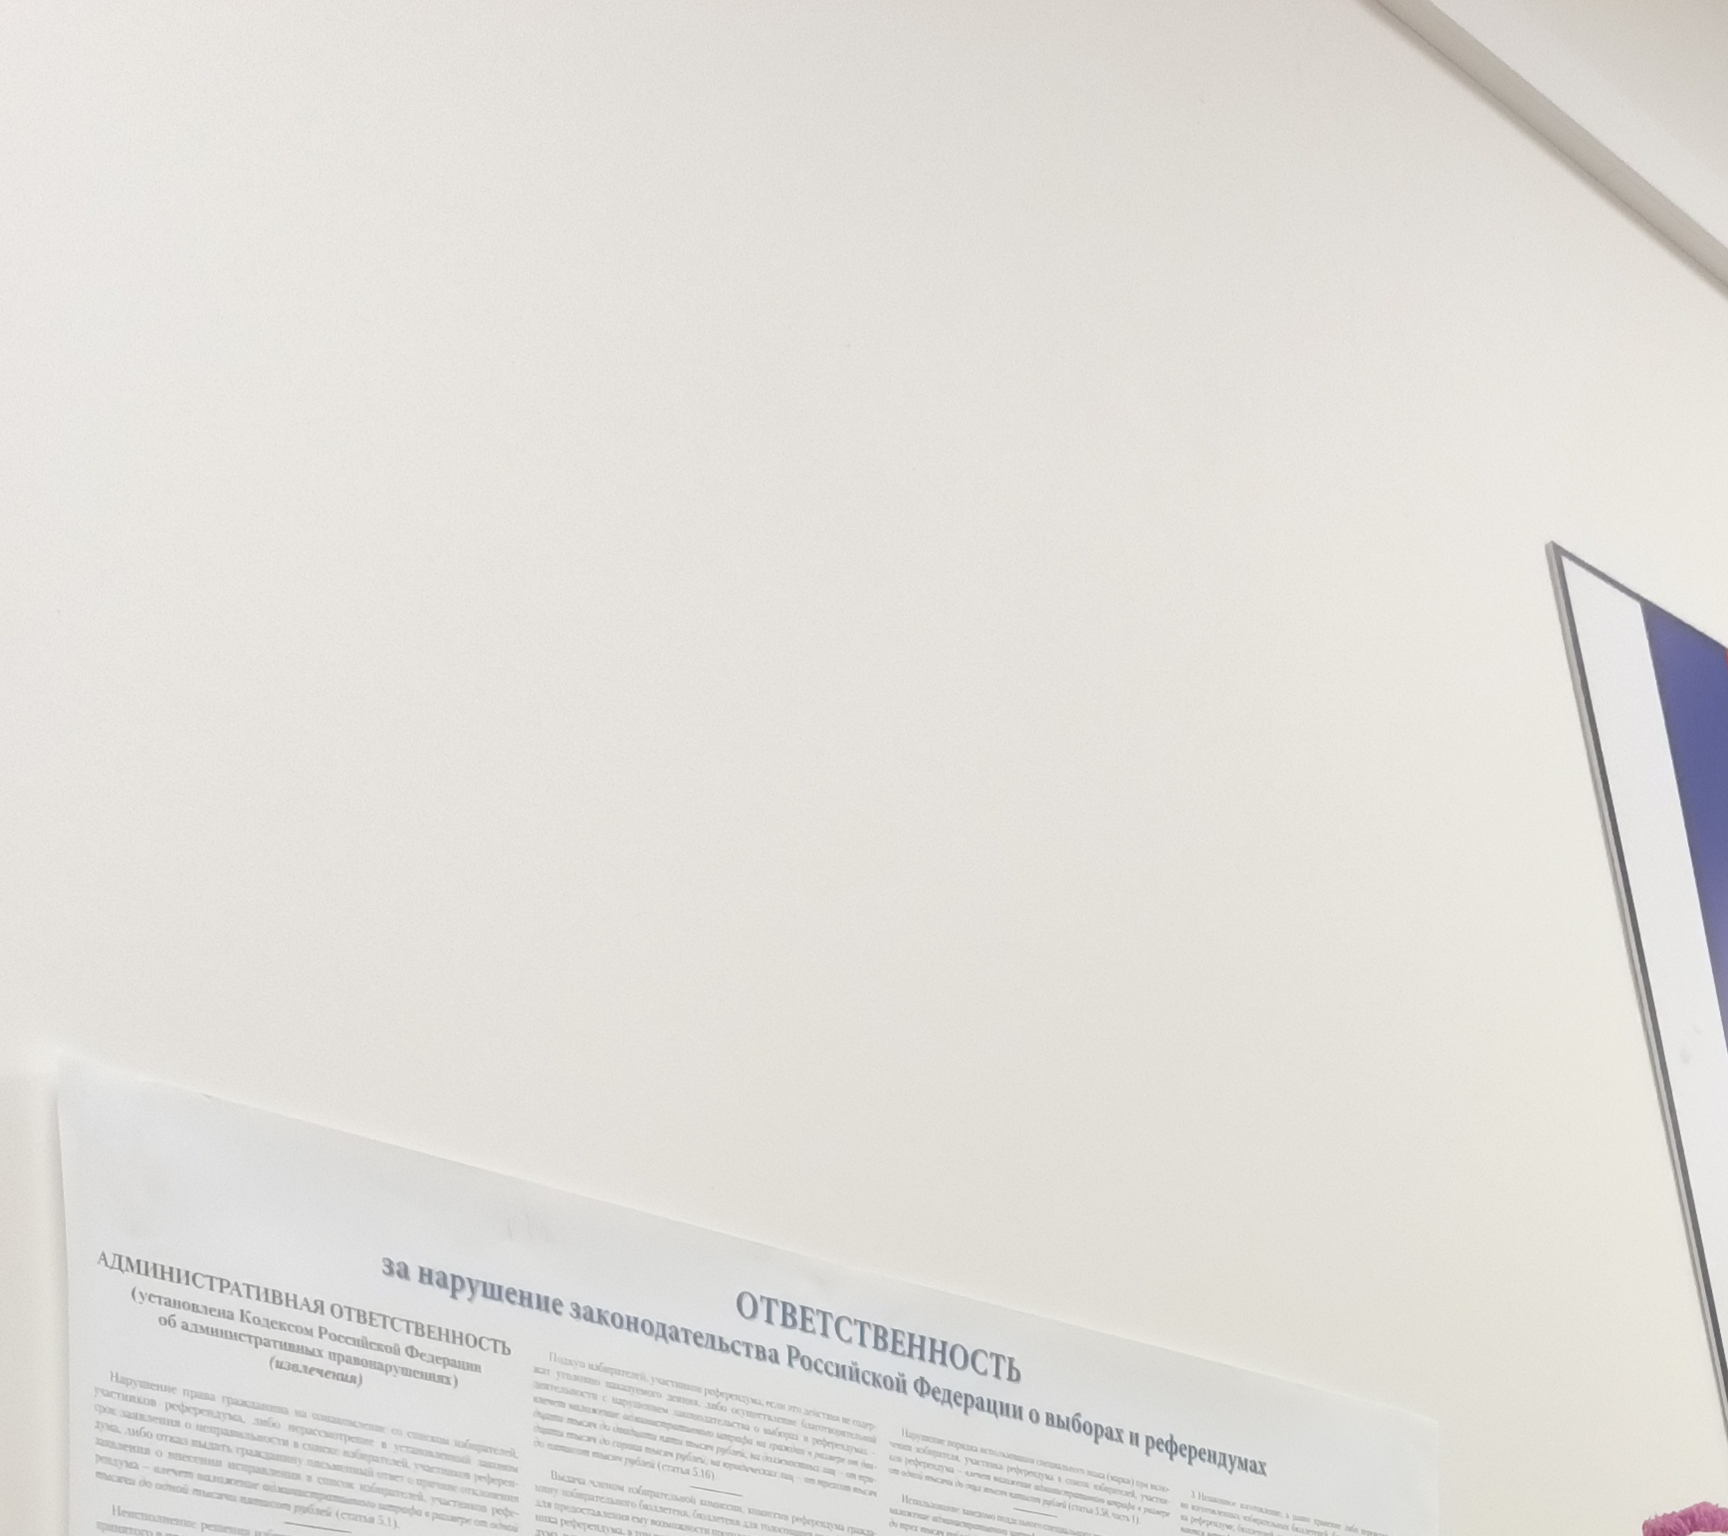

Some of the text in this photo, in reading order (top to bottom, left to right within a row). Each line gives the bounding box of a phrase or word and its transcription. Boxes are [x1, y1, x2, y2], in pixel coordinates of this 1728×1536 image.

[96, 1250, 512, 1356] АДМИНИСТРАТИВНАЯ ОТВЕТСТВЕННОСТЬ
[129, 1285, 482, 1374] (установлена Кодексом Российской Федерации
[736, 1291, 1021, 1382] ОТВЕТСТВЕННОСТЬ
[157, 1312, 459, 1389] об административных правонарушениях)
[268, 1355, 363, 1387] (извлечения)
[382, 1257, 1266, 1476] за нарушение законодательства Российской Федерации о выборах и референдумах
